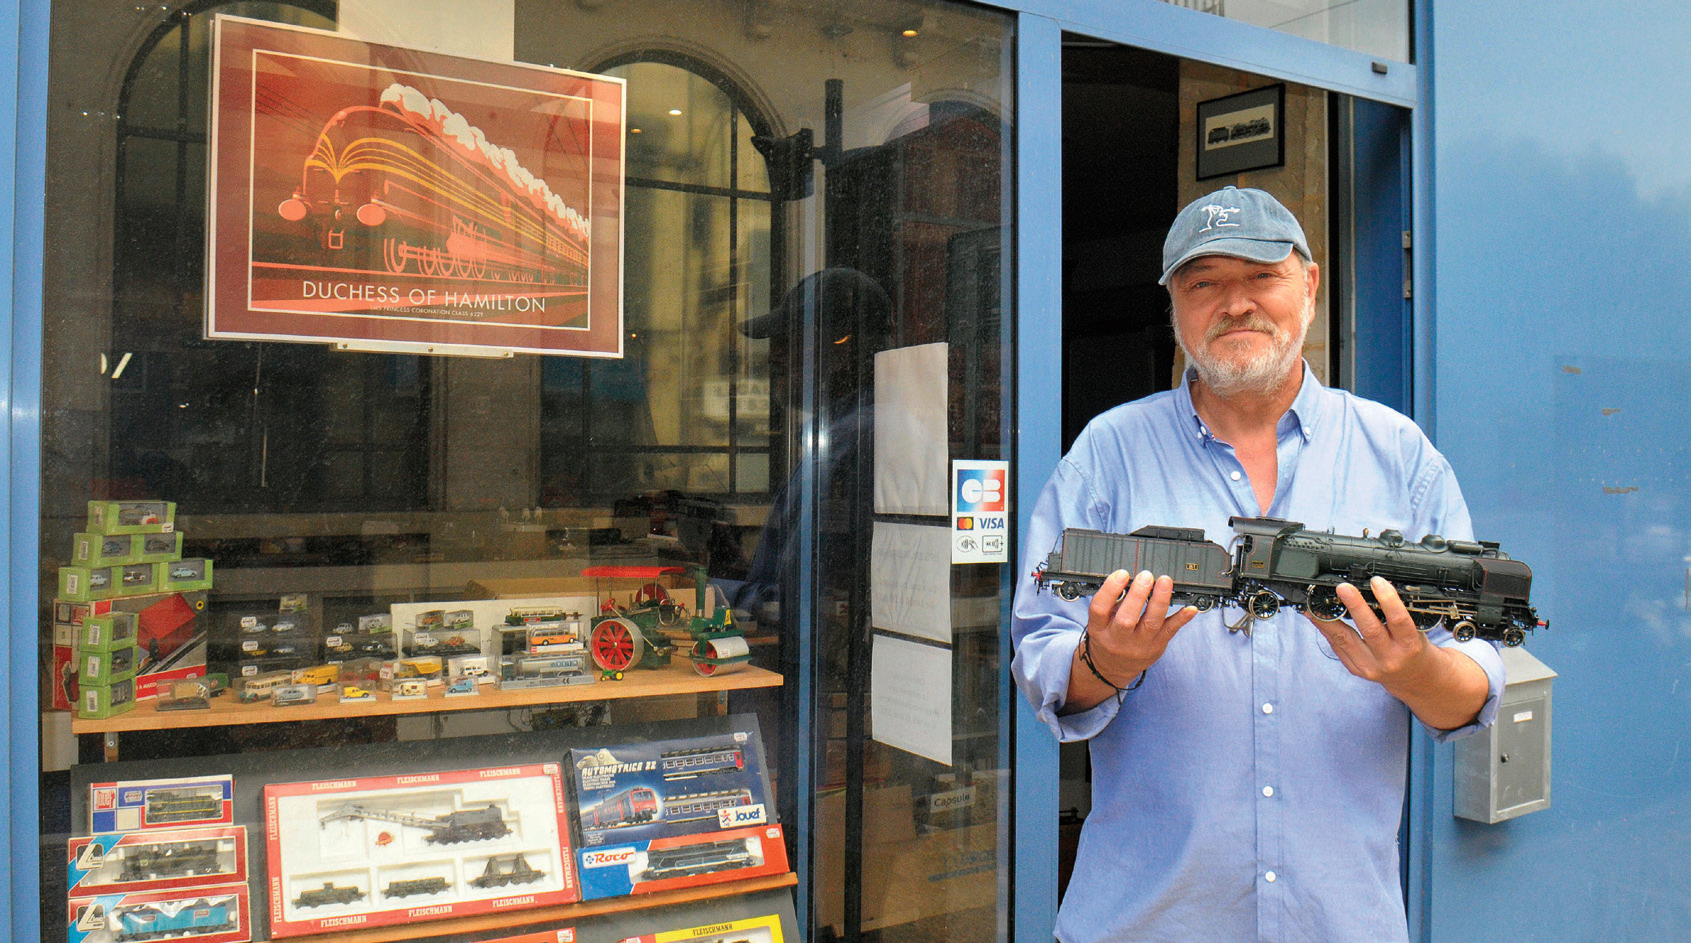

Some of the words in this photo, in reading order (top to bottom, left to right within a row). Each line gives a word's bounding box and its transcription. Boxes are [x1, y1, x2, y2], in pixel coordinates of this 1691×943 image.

[303, 280, 400, 303] DUCHESS
[408, 288, 437, 306] OF
[445, 291, 546, 313] HAMILTON
[411, 307, 450, 316] CORONATION
[978, 517, 1005, 529] VISA
[397, 774, 440, 784] FLEISCHMANN
[480, 768, 521, 778] FLEISCHMANN
[312, 780, 357, 791] FLEISCHMANN
[268, 796, 278, 841] FLEISCHMANN
[735, 807, 761, 822] Jouef
[594, 851, 635, 864] Roco
[562, 846, 573, 889] FLEISCHMANN
[272, 876, 282, 923] FLEISCHMANN
[492, 895, 535, 908] FLEISCHMANN
[408, 905, 453, 917] FLEISCHMANN
[320, 915, 367, 928] FLEISCHMANN
[693, 923, 733, 937] FLEISCHMANN
